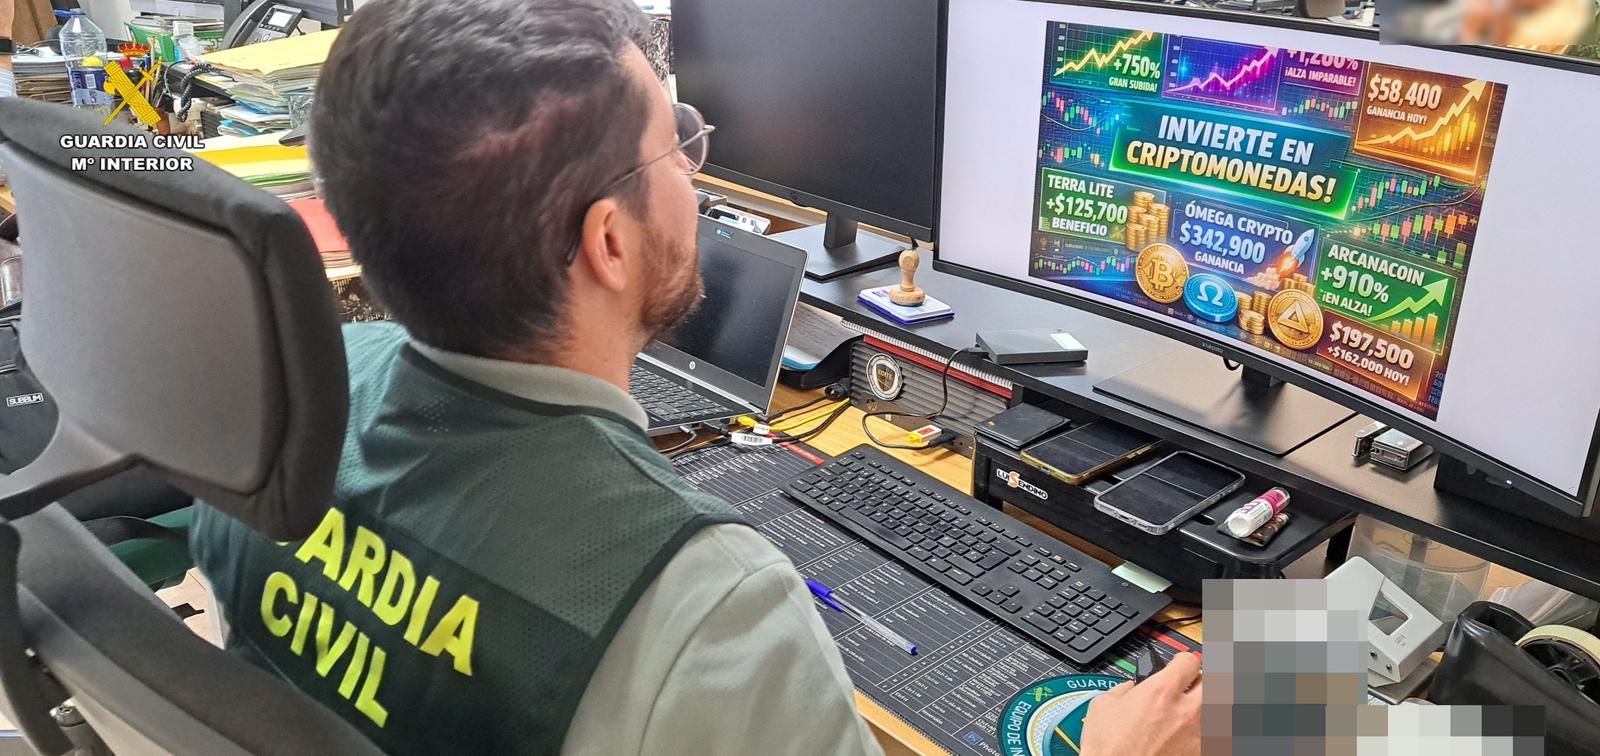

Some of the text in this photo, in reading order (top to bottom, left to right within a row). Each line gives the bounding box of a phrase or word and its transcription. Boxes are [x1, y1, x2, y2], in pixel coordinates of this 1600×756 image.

[1113, 53, 1161, 79] +750%
[1285, 67, 1356, 87] ¡ALZA IMPARABLE!
[1108, 76, 1157, 92] GRAN SUBIDA!
[1368, 74, 1442, 110] $58,400
[1366, 105, 1427, 126] GANANCIA HOY!
[1158, 115, 1314, 165] INVIERTE EN
[1048, 174, 1114, 198] TERRA LITE
[1126, 140, 1336, 203] CRIPTOMONEDAS!
[1046, 194, 1128, 224] +$125,700
[1185, 200, 1293, 245] ÓMEGA CRYPTO
[1052, 217, 1107, 236] BENEFICIO
[1179, 222, 1265, 264] $342,900
[1195, 251, 1244, 274] GANANCIA
[1328, 244, 1424, 286] ARCANACOIN
[1321, 266, 1389, 303] +910%
[1322, 289, 1372, 316] ¡EN ALZA!
[1330, 321, 1414, 369] $197,500
[1328, 345, 1383, 374] +$162,000
[1384, 368, 1410, 386] HOY!
[275, 507, 480, 676] ARDIA
[260, 571, 388, 728] CIVIL
[1067, 679, 1122, 689] GUARD
[1008, 700, 1032, 731] EQUIPO
[1007, 732, 1021, 745] DE
